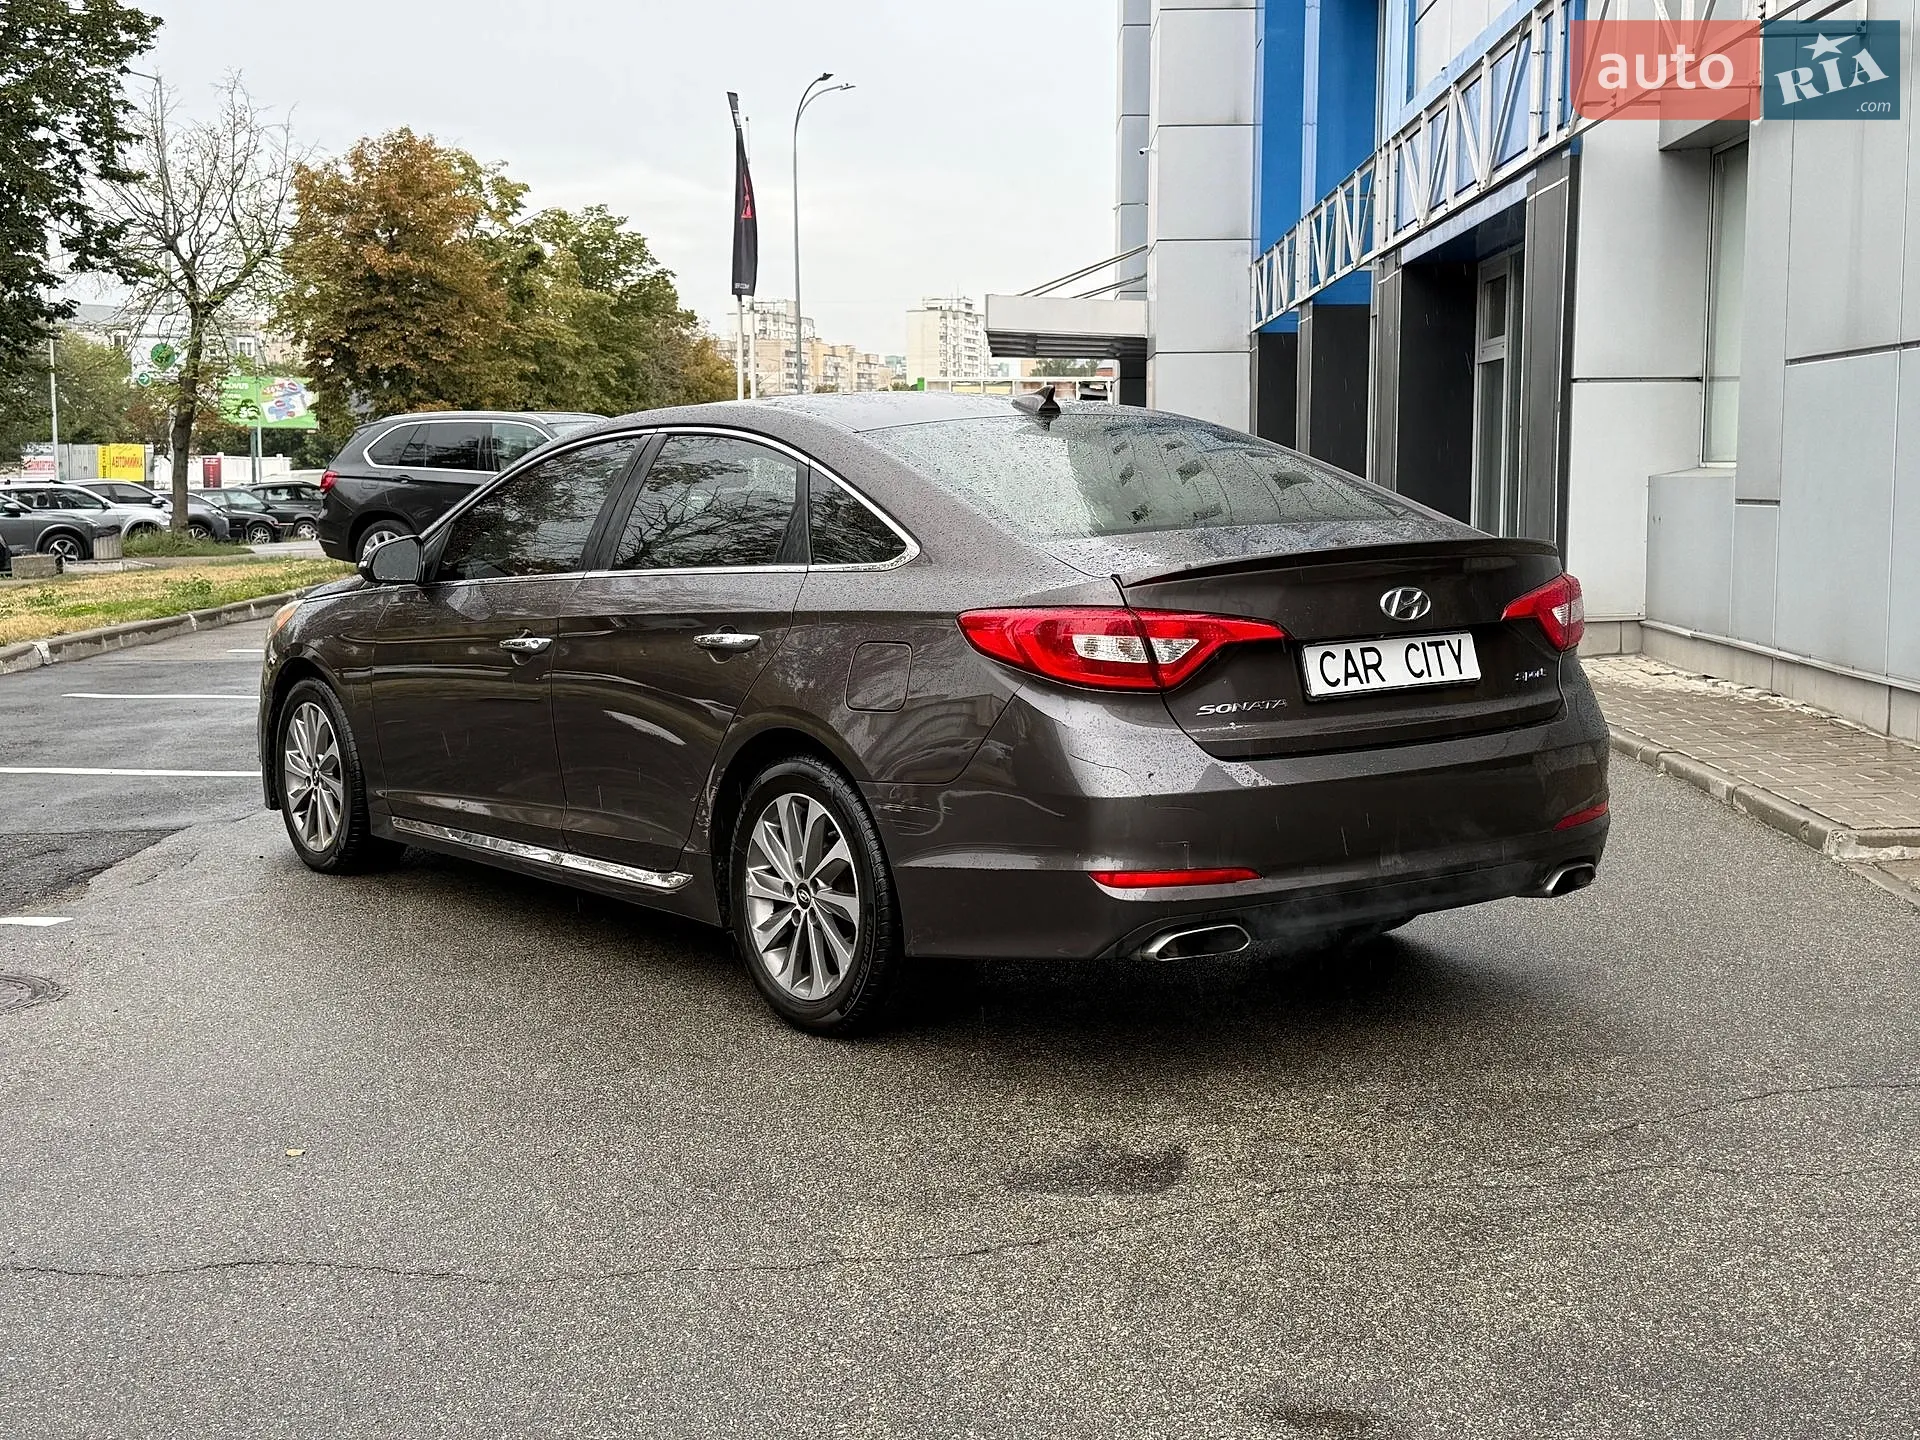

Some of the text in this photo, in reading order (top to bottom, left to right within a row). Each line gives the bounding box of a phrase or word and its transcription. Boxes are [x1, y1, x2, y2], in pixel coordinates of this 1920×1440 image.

[111, 454, 143, 469] АВТОМИЙКА
[1319, 639, 1463, 688] CAR CITY
[1196, 698, 1288, 716] SONATA
